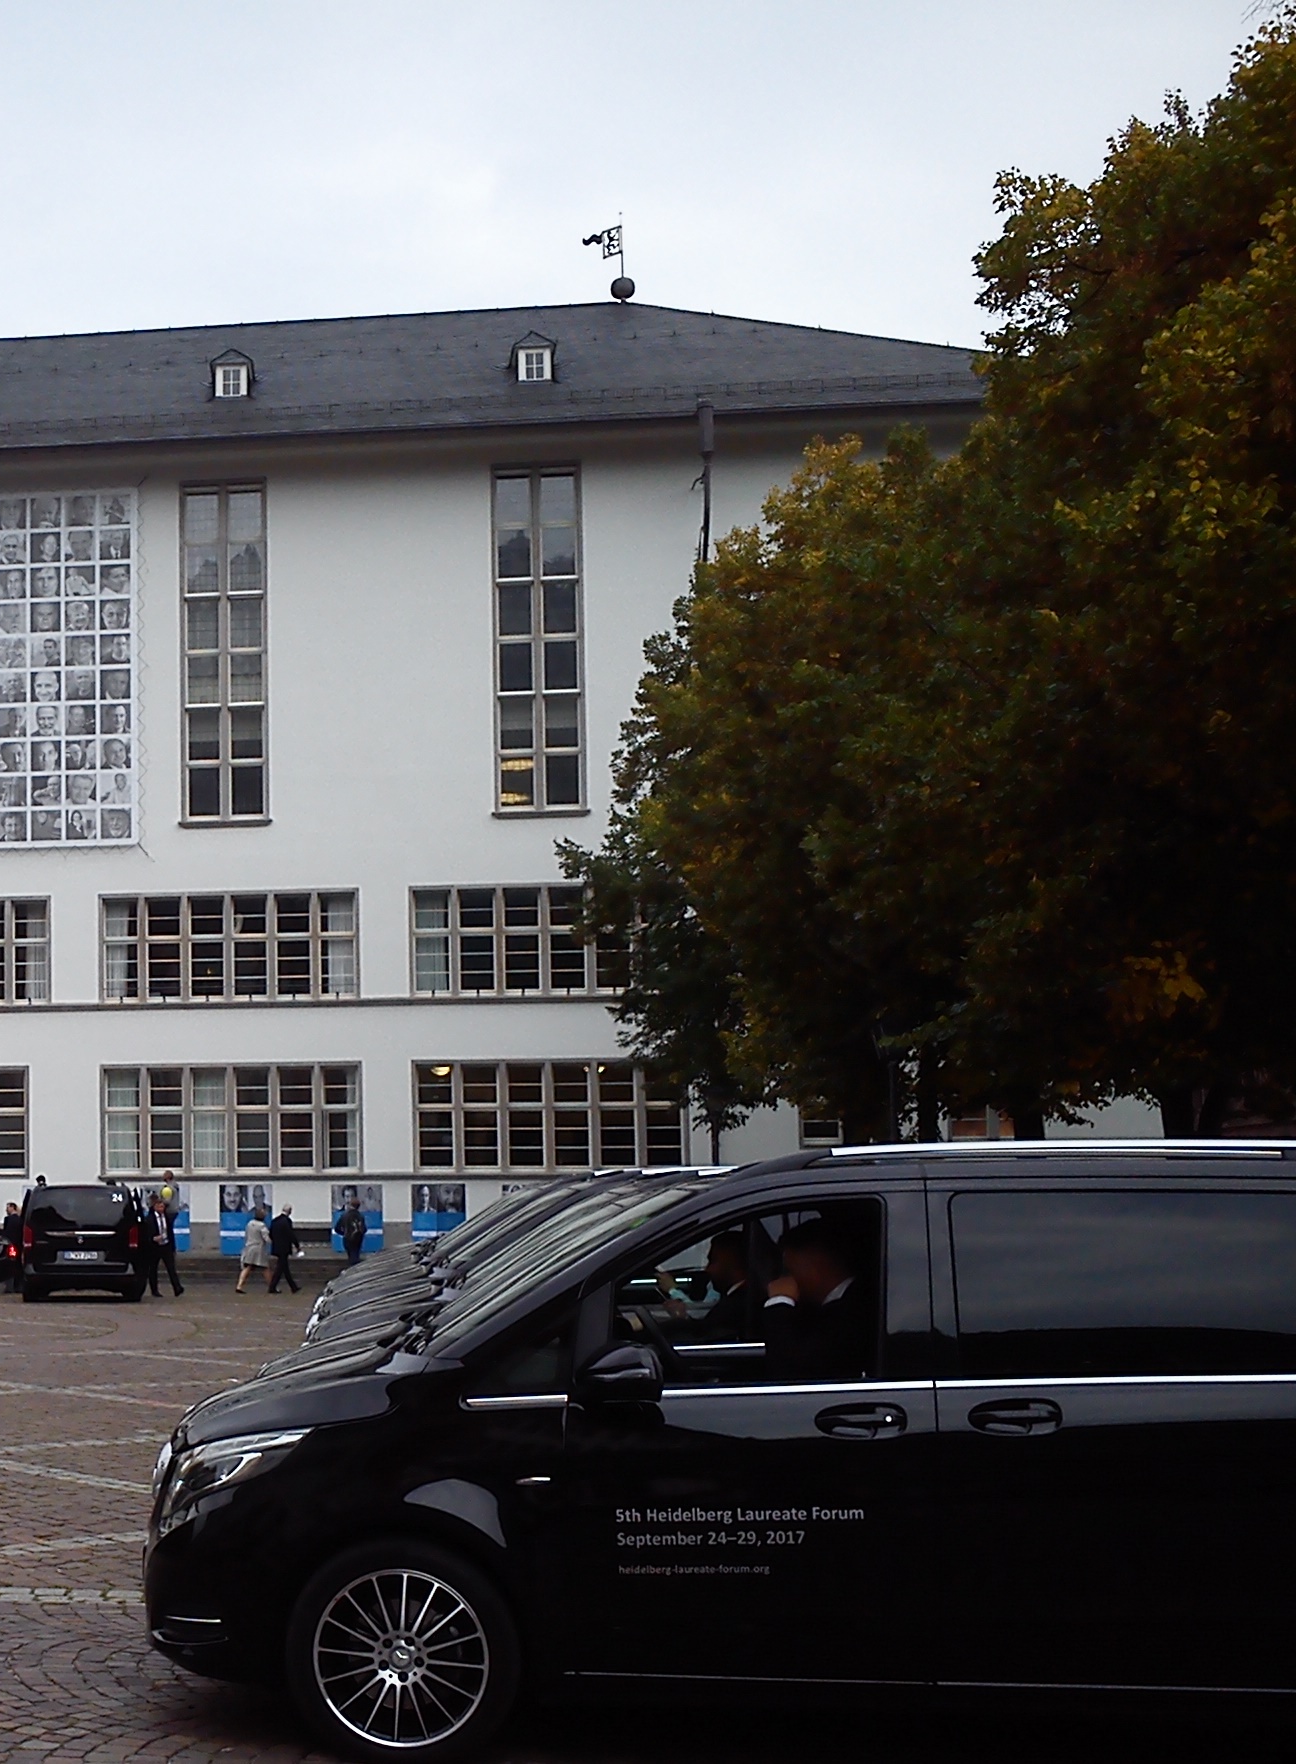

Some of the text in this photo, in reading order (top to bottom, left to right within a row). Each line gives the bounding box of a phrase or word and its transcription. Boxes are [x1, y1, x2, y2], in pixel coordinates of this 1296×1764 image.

[111, 1193, 124, 1203] 24
[615, 1506, 865, 1524] 5th Heidelberg Laureate Forum
[616, 1532, 703, 1548] September
[766, 1530, 805, 1545] 2017
[617, 1563, 771, 1576] heidelberg-laureate-forum.org
